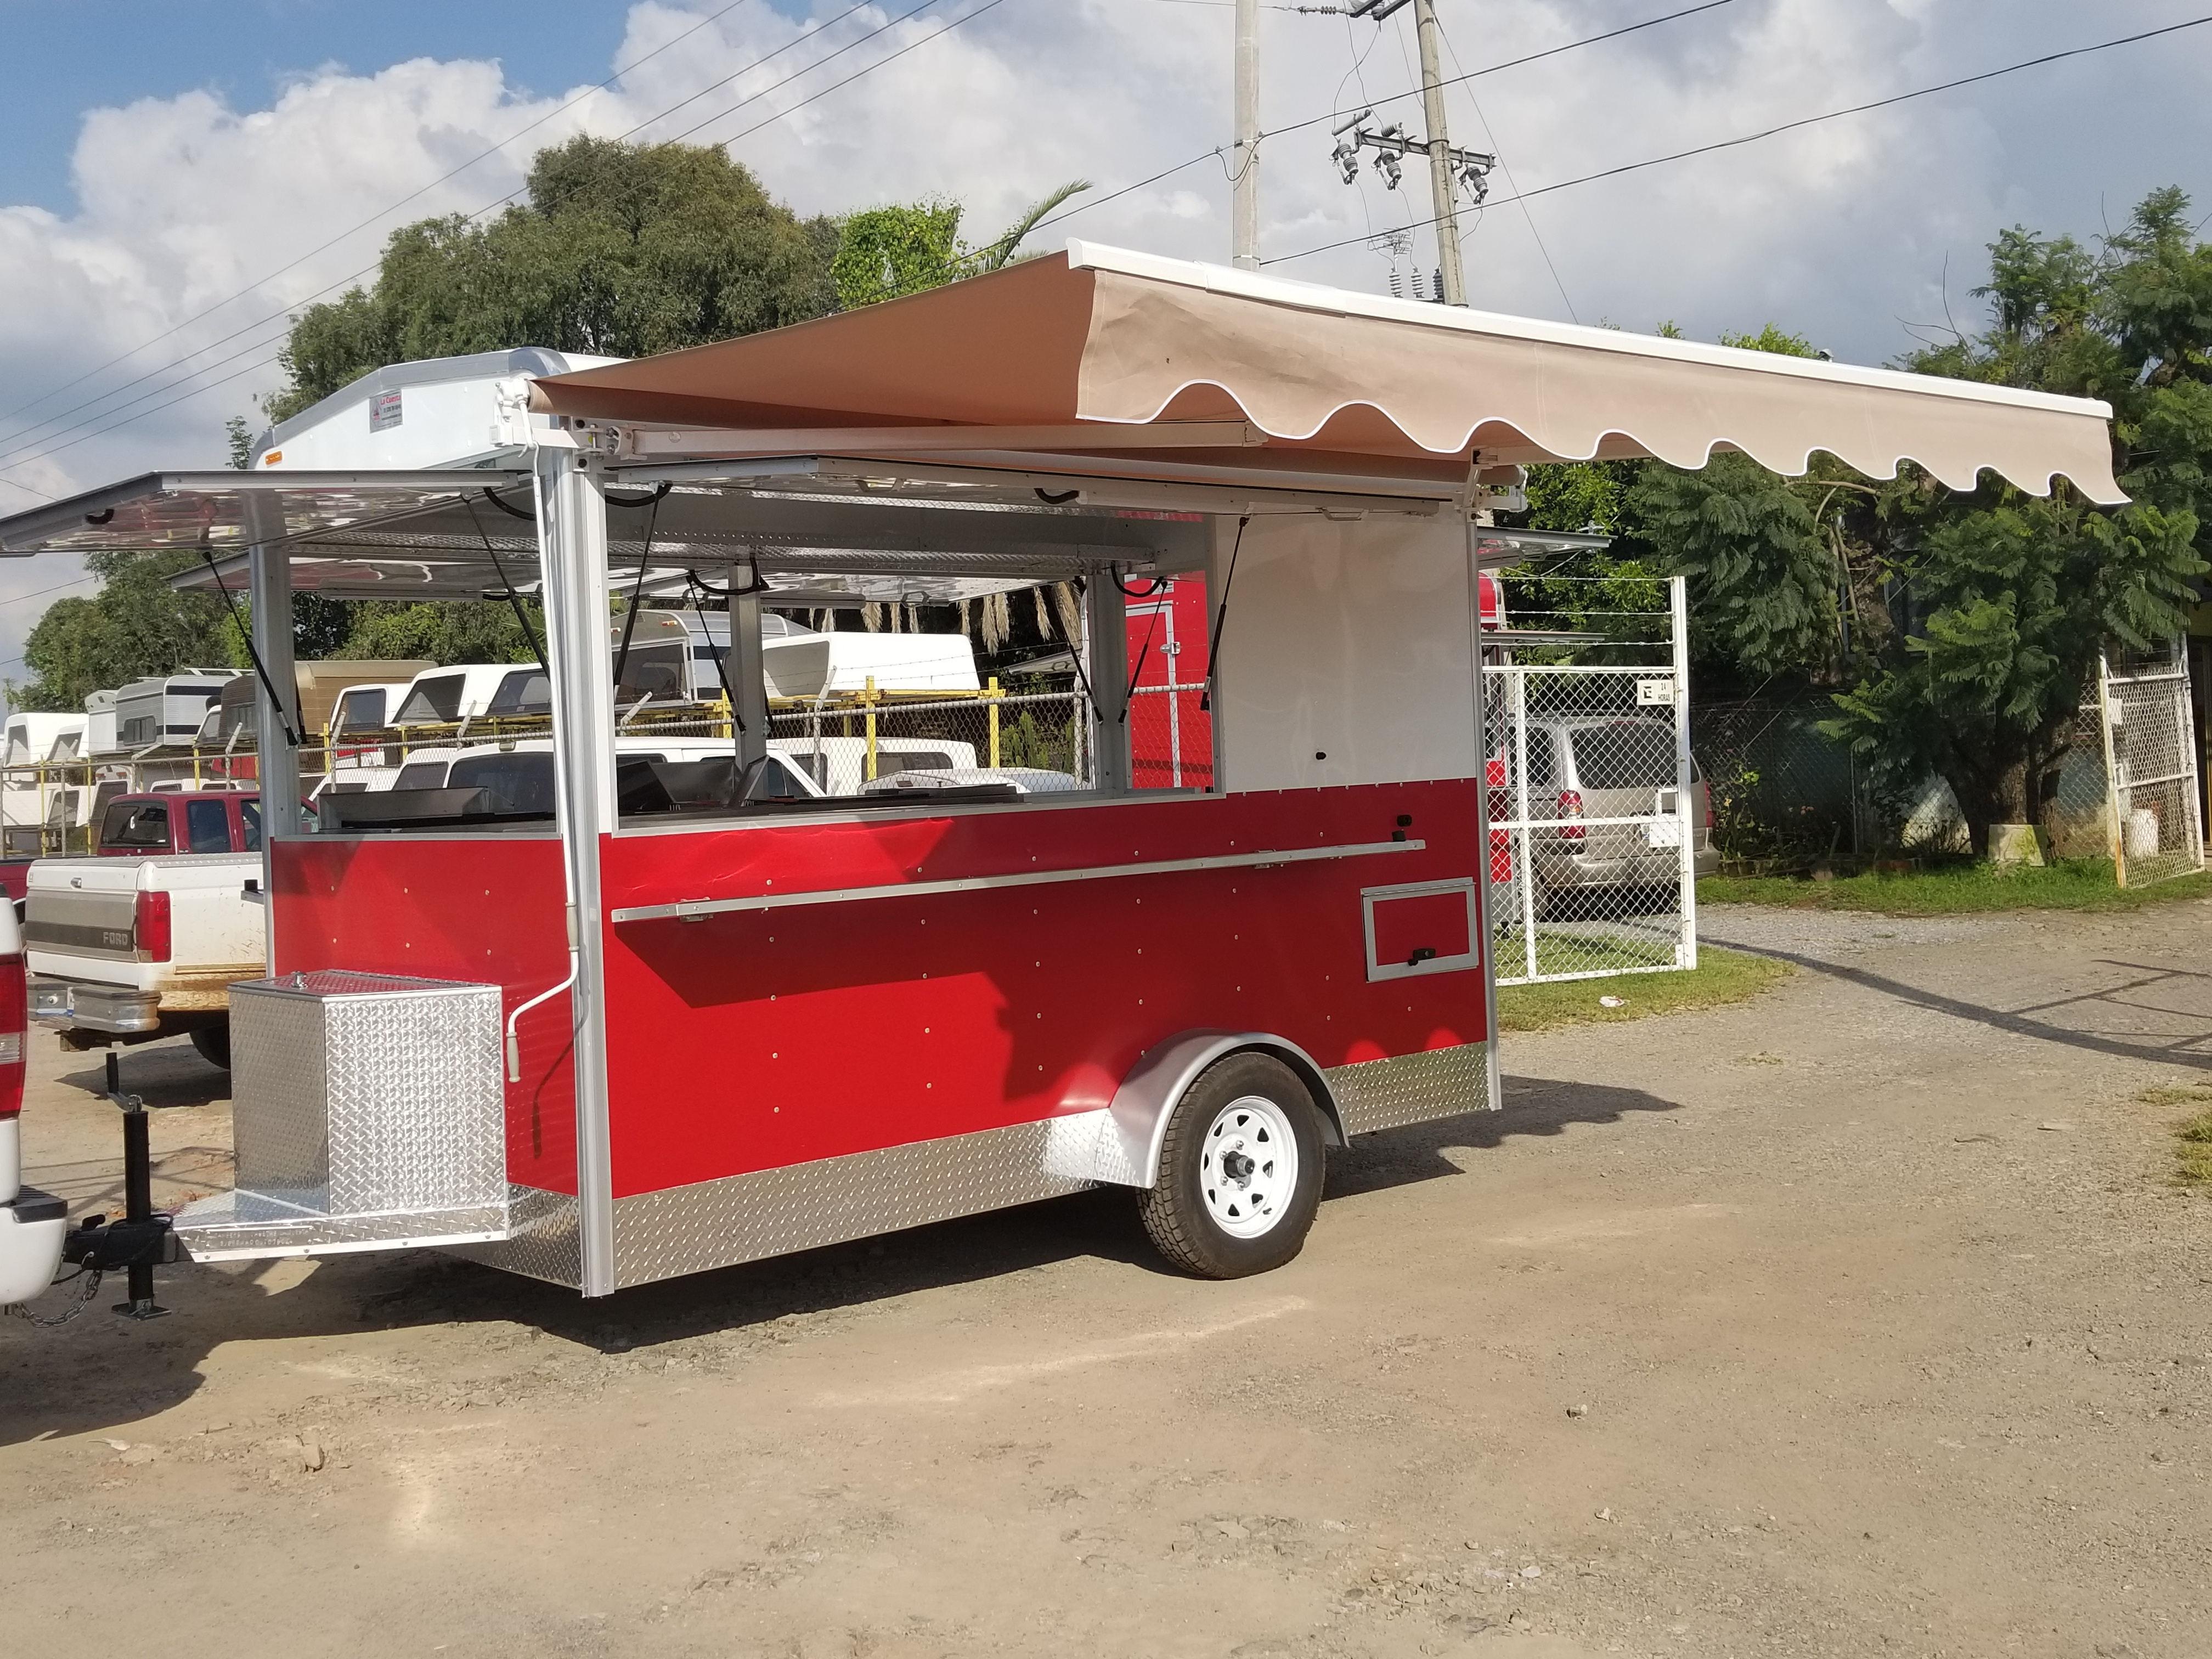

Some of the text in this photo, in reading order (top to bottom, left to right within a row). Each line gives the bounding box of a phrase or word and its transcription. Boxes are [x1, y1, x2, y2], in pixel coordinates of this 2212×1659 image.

[1661, 682, 1666, 691] 24
[1658, 693, 1671, 702] HORAS
[103, 932, 128, 946] FORD
